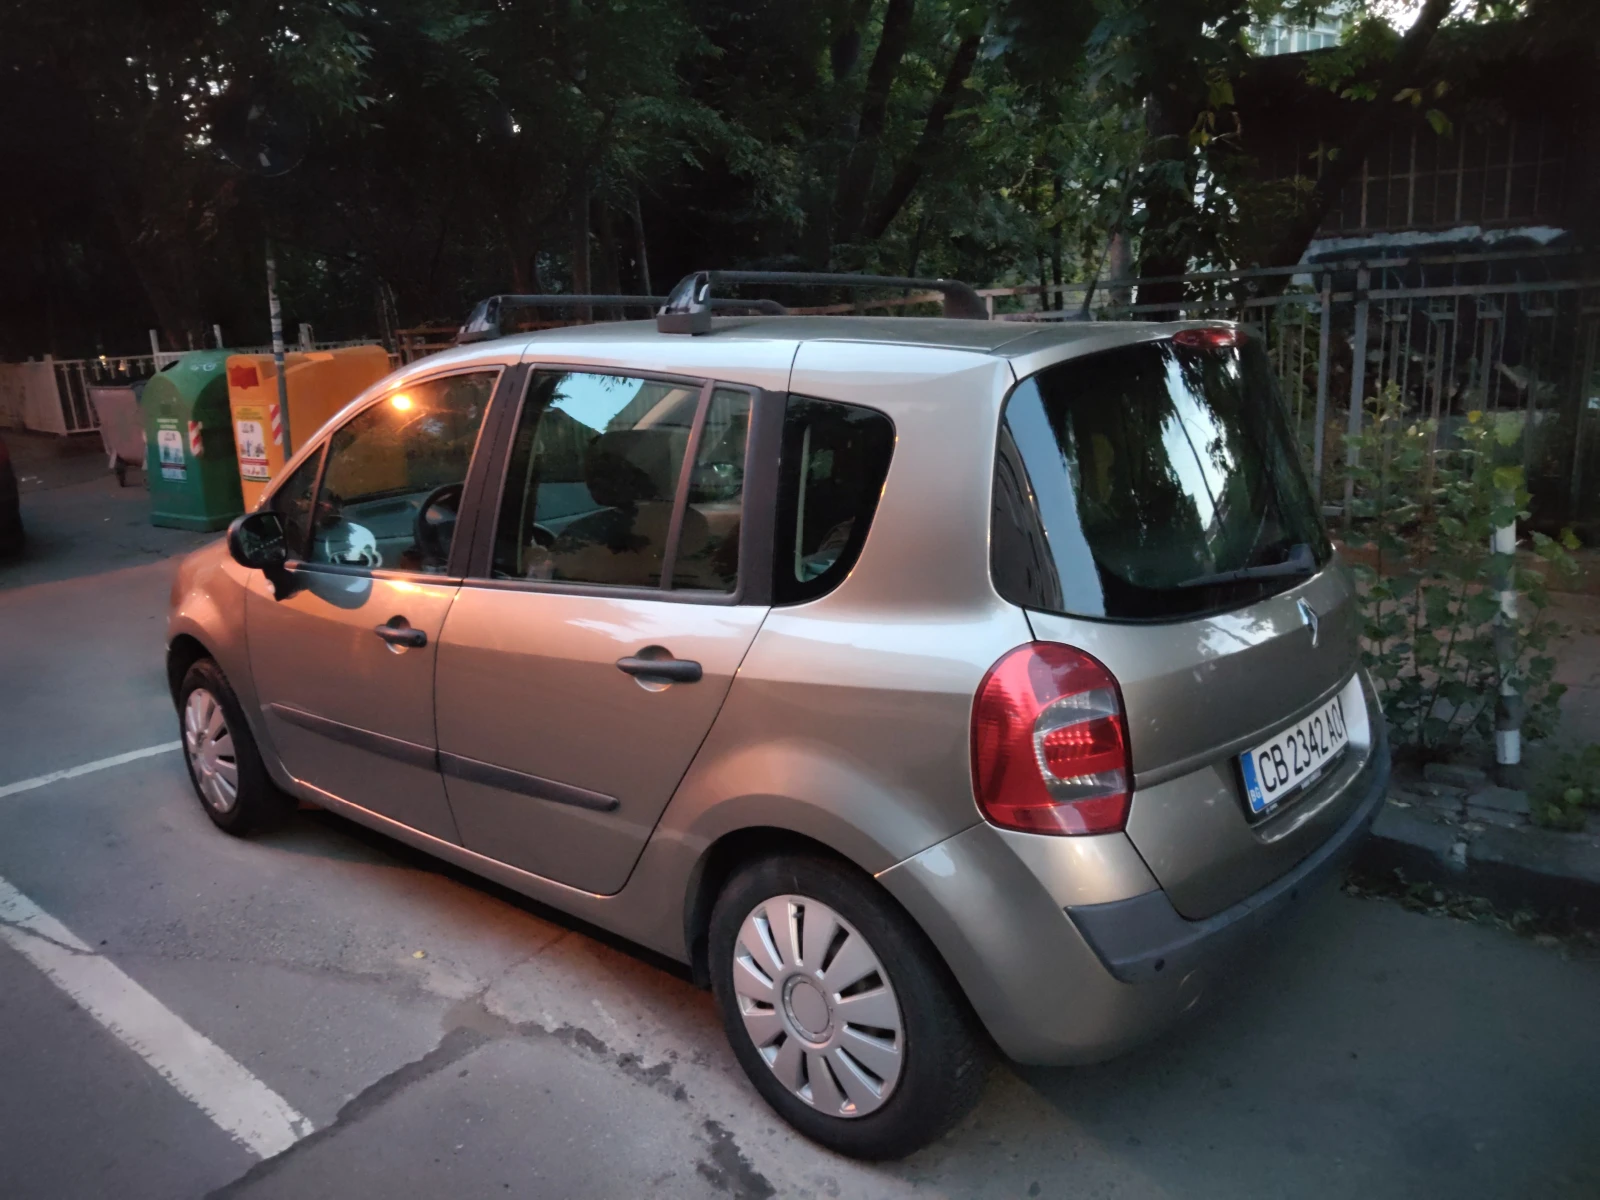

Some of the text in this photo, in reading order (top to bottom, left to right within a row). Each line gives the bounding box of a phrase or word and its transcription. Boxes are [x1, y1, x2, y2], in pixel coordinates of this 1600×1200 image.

[1258, 743, 1289, 793] CB
[1286, 716, 1329, 777] 2342
[1250, 787, 1262, 802] BG
